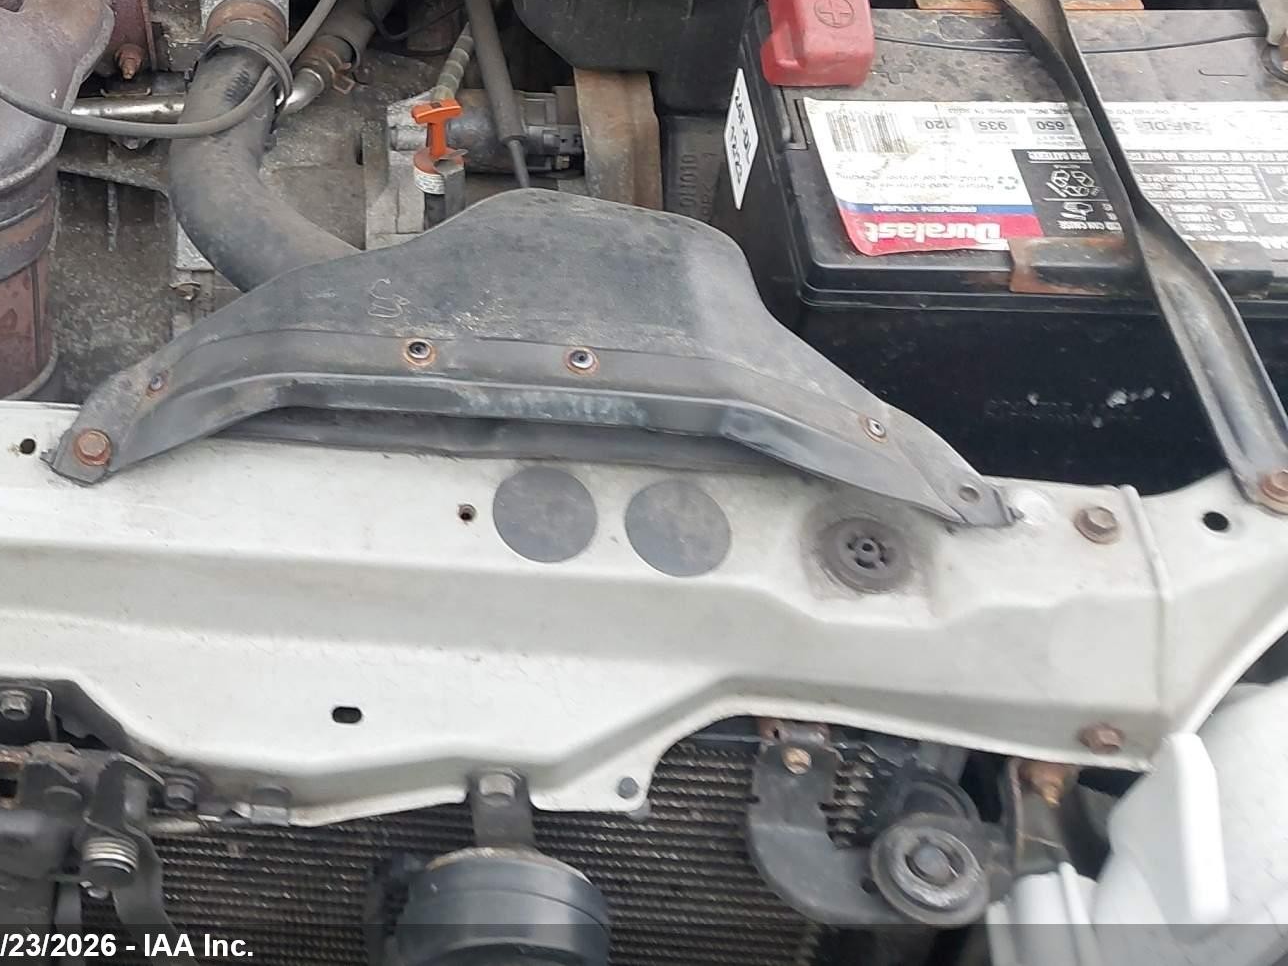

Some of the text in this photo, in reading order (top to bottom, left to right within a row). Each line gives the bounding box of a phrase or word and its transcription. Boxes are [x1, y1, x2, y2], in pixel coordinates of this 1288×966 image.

[925, 120, 951, 130] 120
[977, 121, 1008, 131] 935
[1036, 121, 1065, 131] 650
[864, 221, 1004, 244] Duralast
